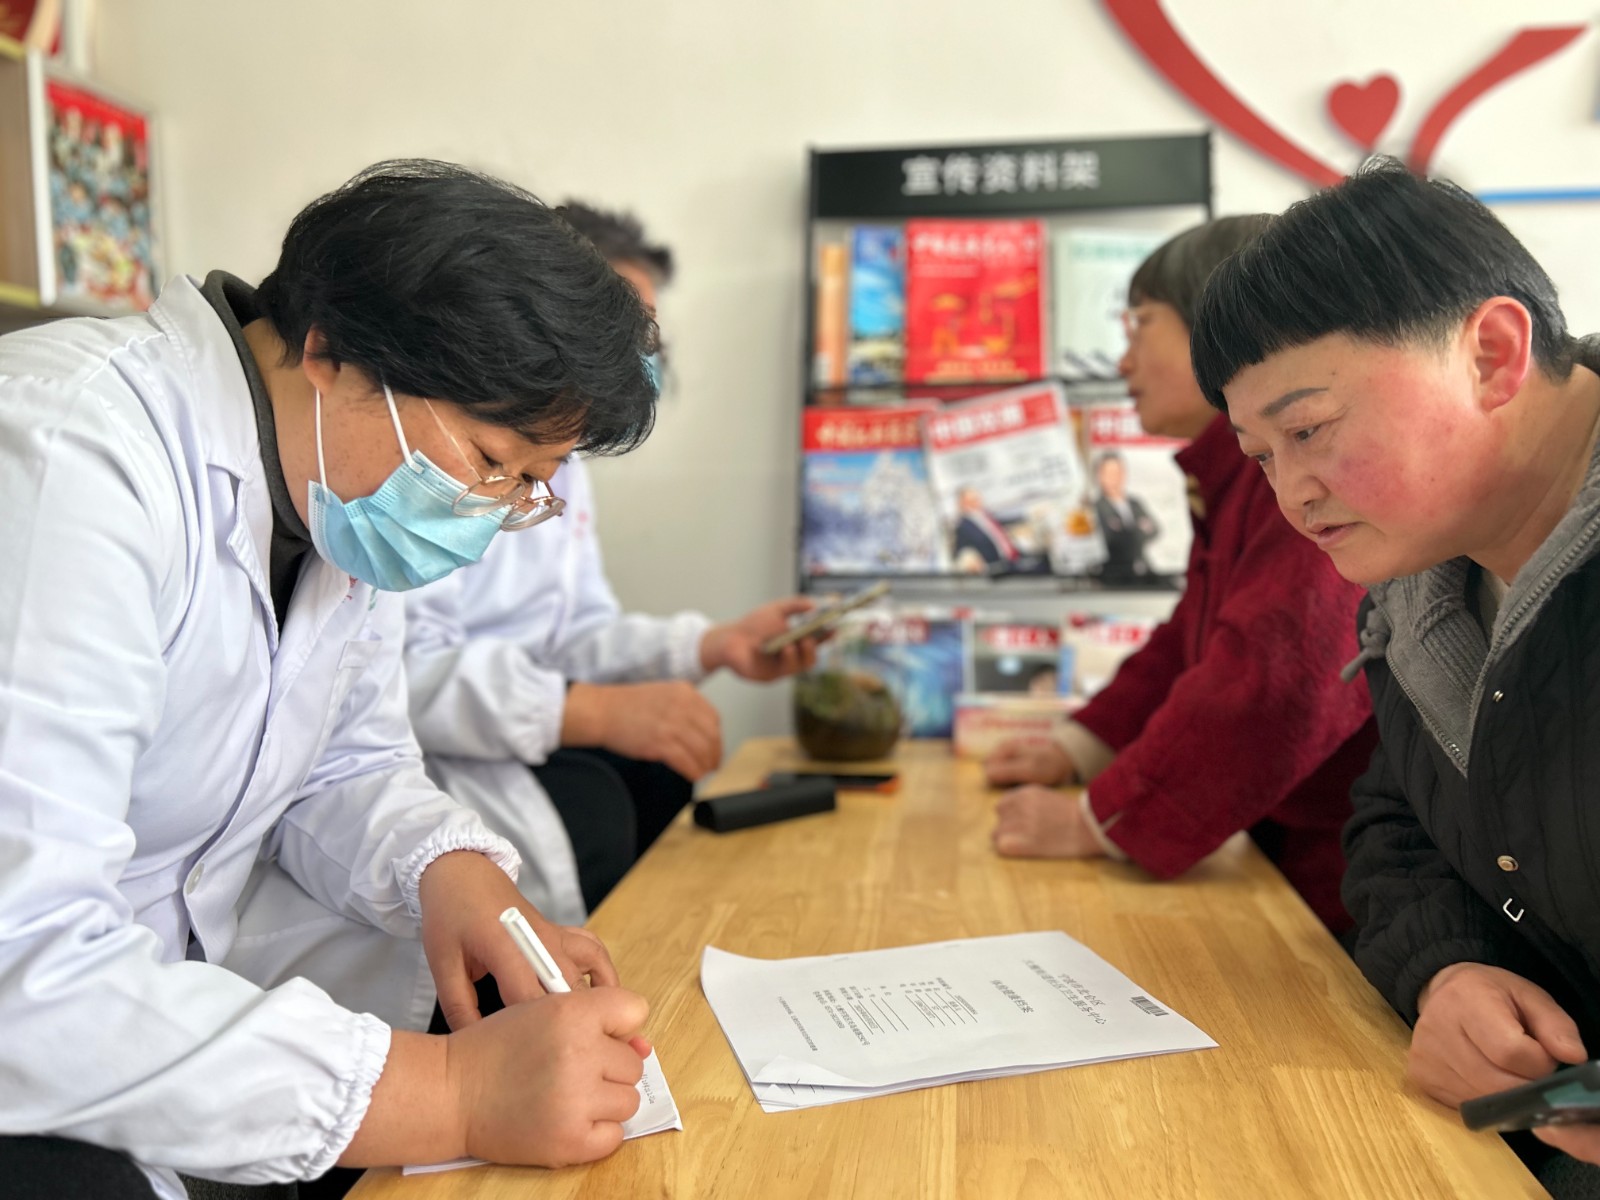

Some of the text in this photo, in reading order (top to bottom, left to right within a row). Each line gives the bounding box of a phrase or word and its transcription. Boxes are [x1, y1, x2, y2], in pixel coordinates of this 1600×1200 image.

[901, 151, 1099, 196] 宣传资料架
